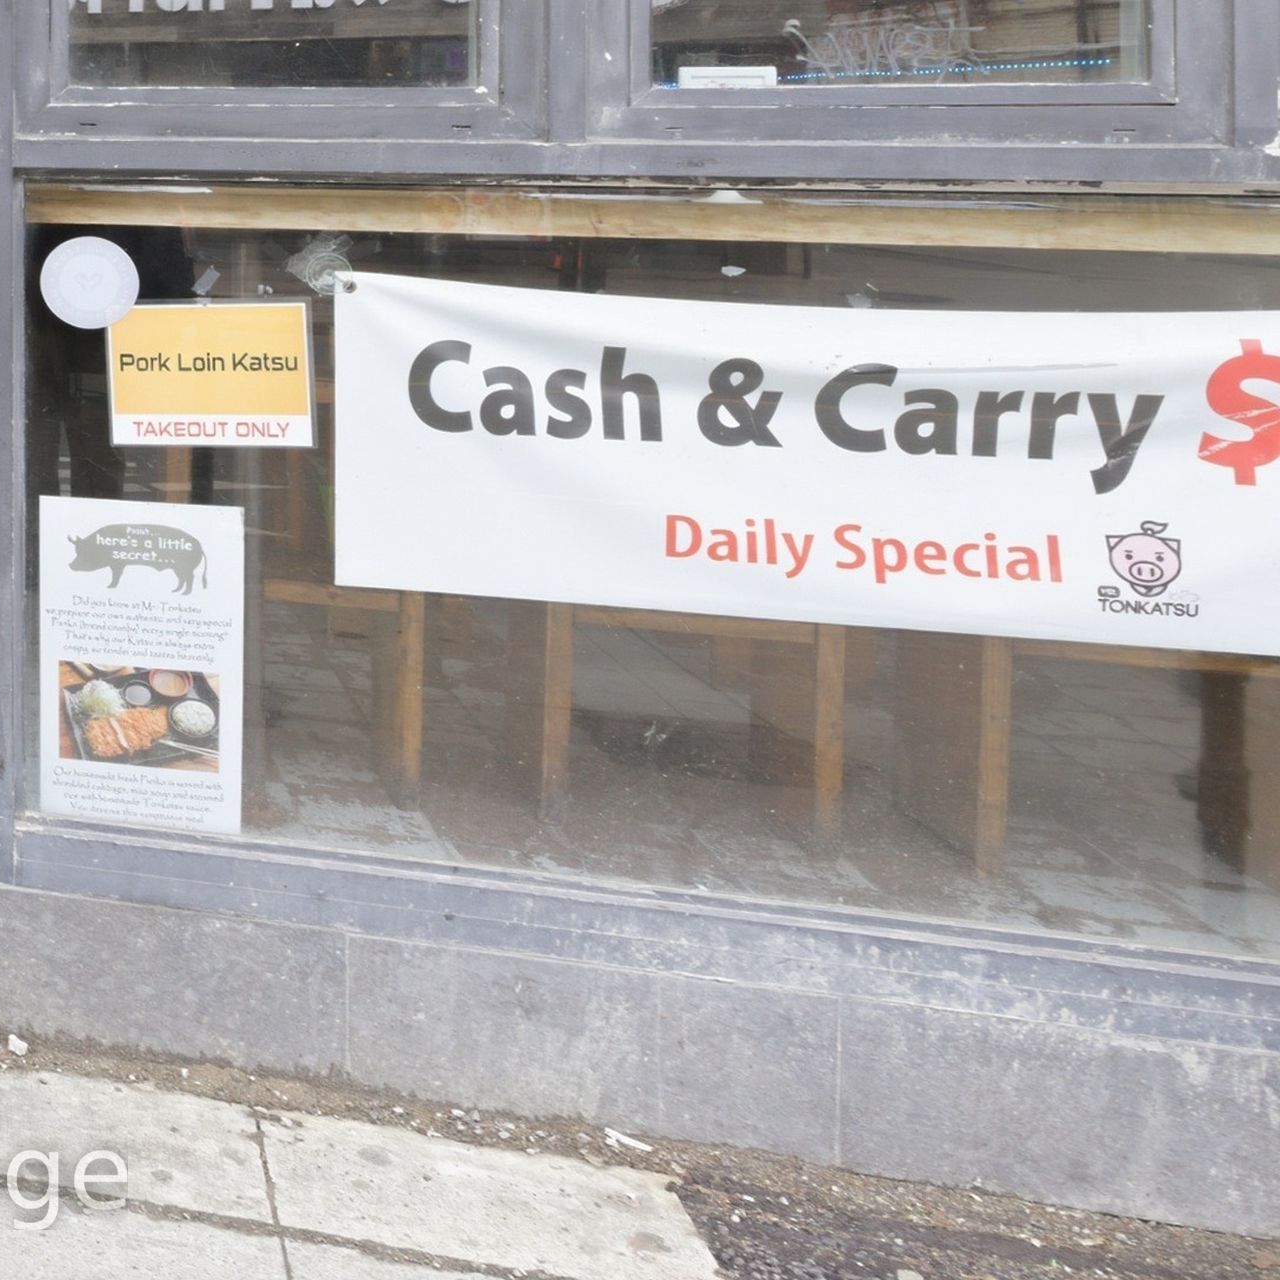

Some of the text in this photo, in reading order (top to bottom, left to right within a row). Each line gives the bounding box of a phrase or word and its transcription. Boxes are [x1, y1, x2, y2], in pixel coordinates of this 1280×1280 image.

[118, 352, 299, 372] Pork Loin Katsu
[407, 338, 664, 443] Cash
[695, 357, 784, 448] &
[813, 362, 1166, 496] Carry
[132, 421, 290, 438] TAKEOUT ONLY
[95, 534, 193, 552] here's a little
[663, 514, 1064, 585] Daily Special
[1097, 597, 1200, 619] TONKATSU
